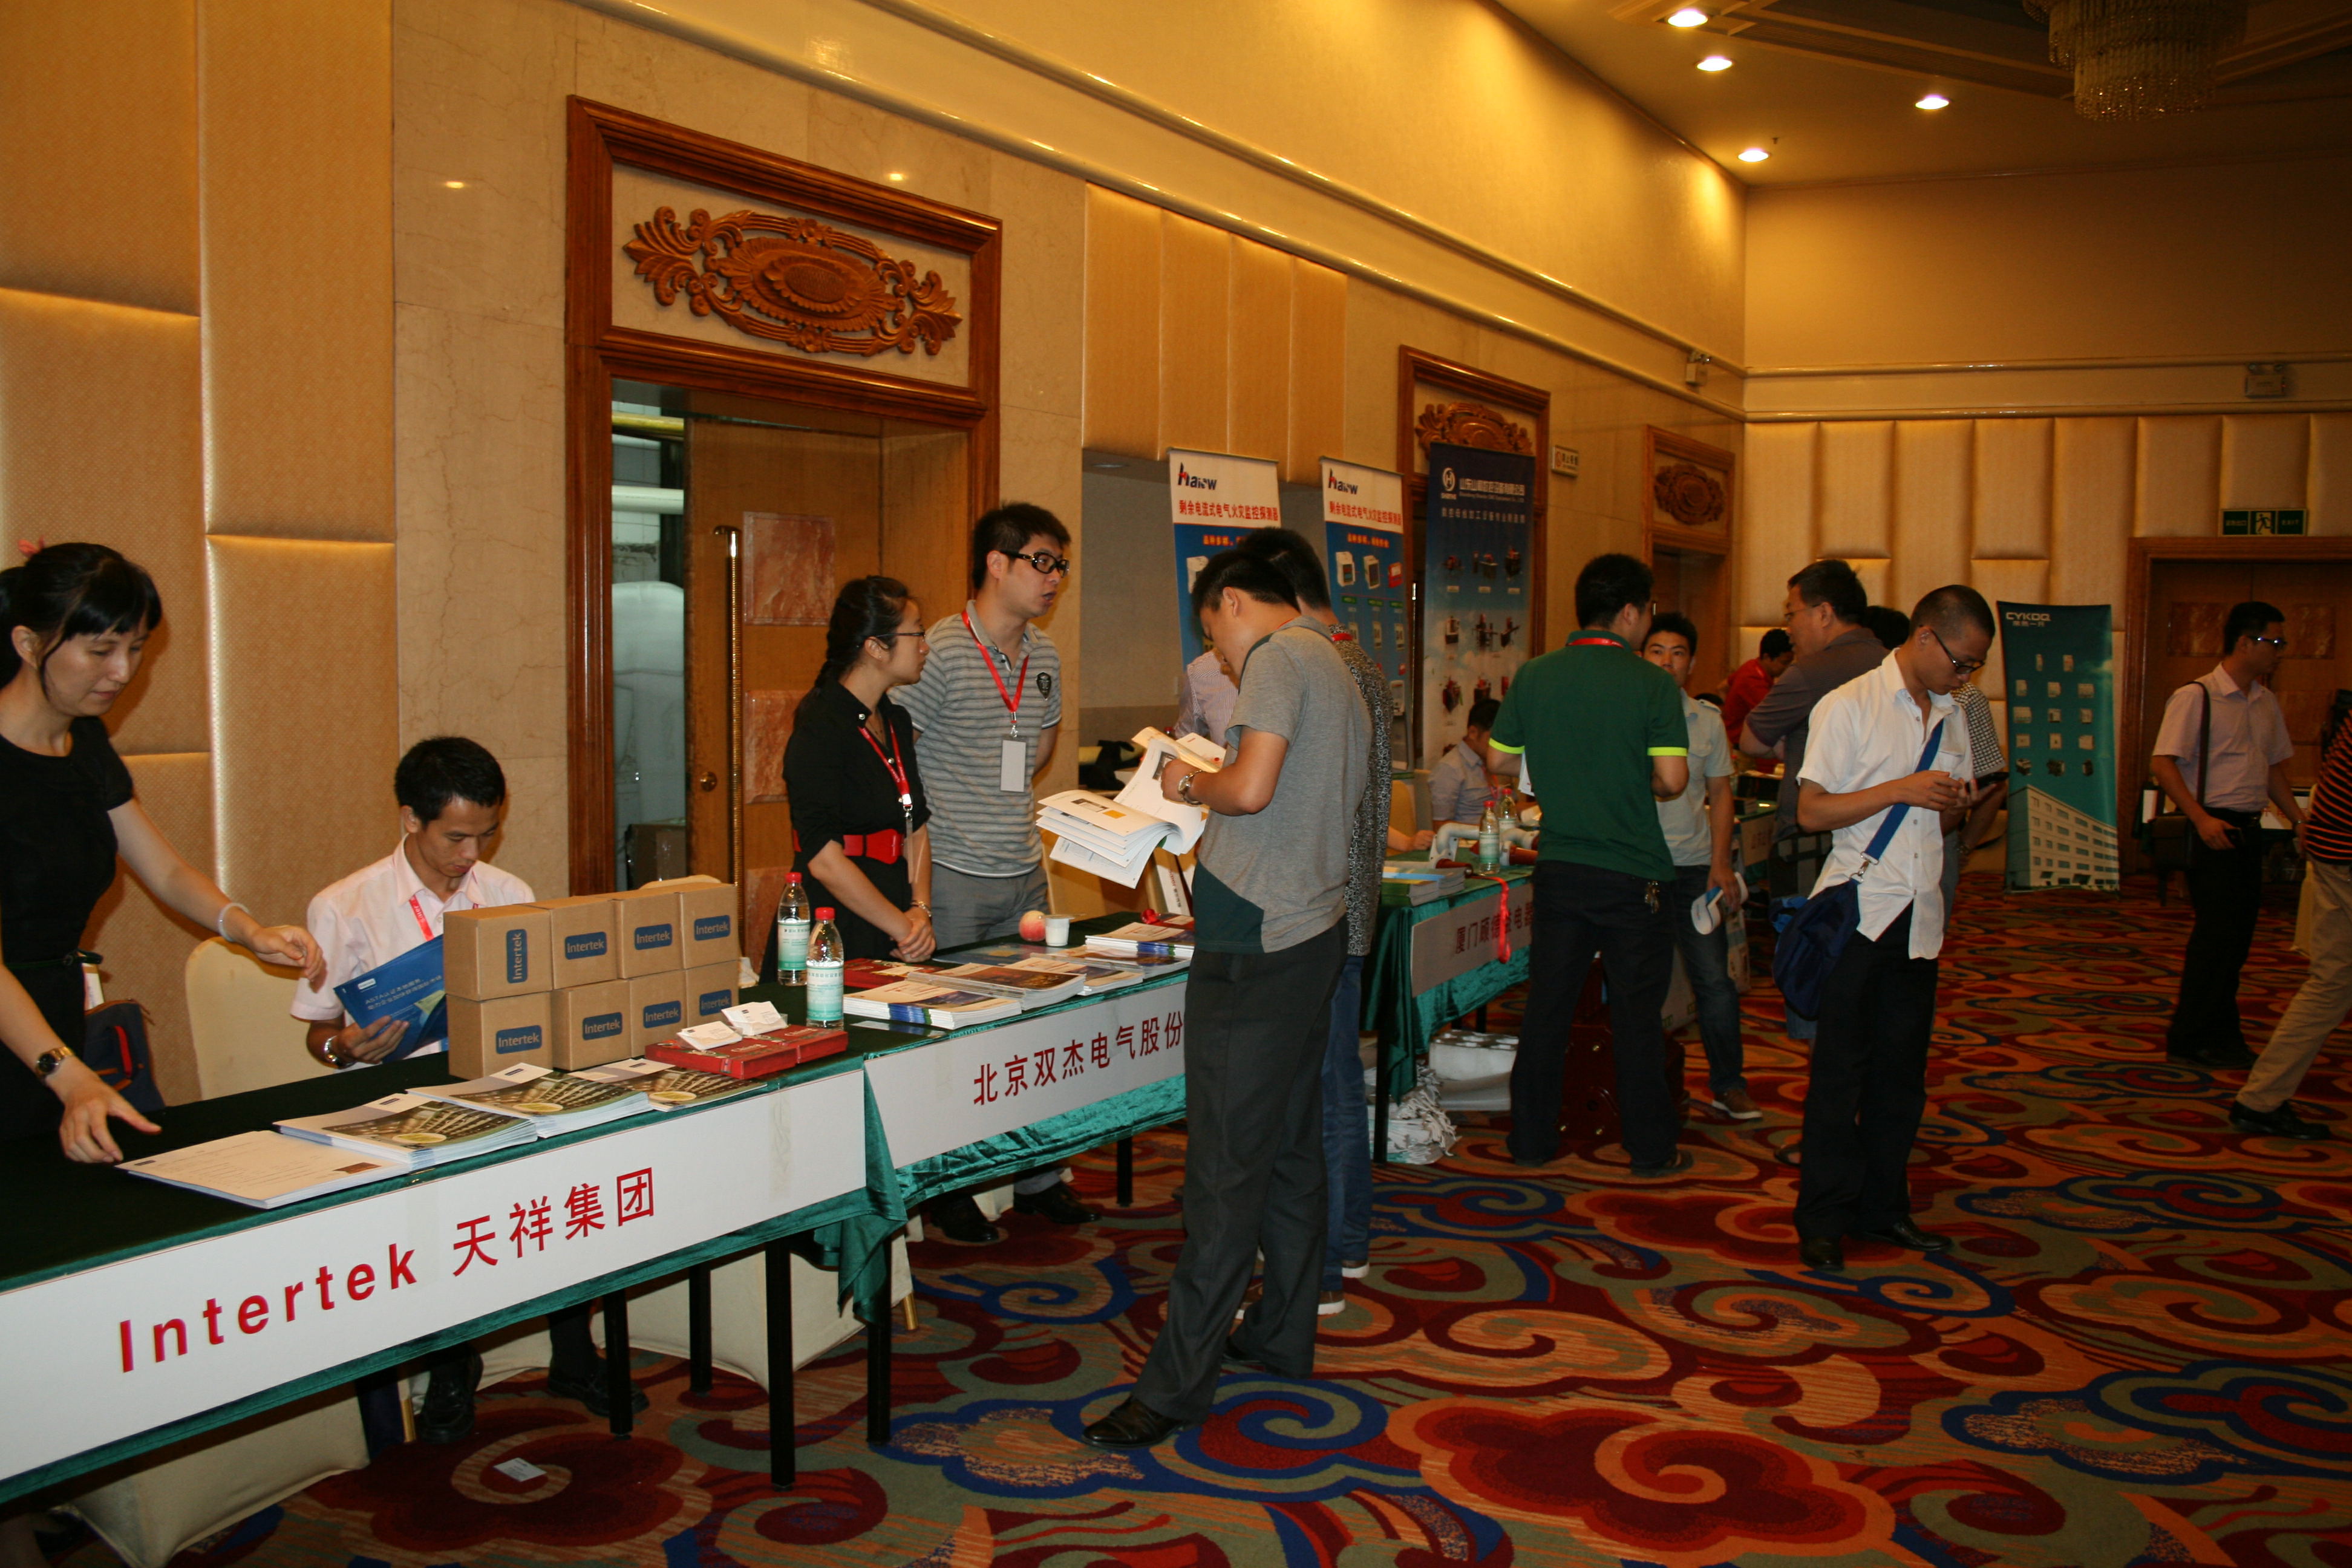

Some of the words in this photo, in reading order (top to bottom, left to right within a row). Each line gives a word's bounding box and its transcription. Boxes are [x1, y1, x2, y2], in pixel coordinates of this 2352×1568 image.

[1179, 500, 1278, 521] 剩余电流式电气火灾监控探测器
[696, 921, 730, 936] Intertek
[636, 930, 670, 944] Intertek
[566, 938, 604, 953] Intertek
[512, 932, 522, 980] Intertek
[701, 996, 731, 1010] Intertek
[645, 1007, 679, 1022] Intertek
[584, 1019, 621, 1034] Intertek
[498, 1032, 539, 1048] Intertek
[973, 1010, 1183, 1106] 北京双杰电气股份
[119, 1242, 417, 1373] Intertek
[452, 1167, 655, 1277] 天祥集团
